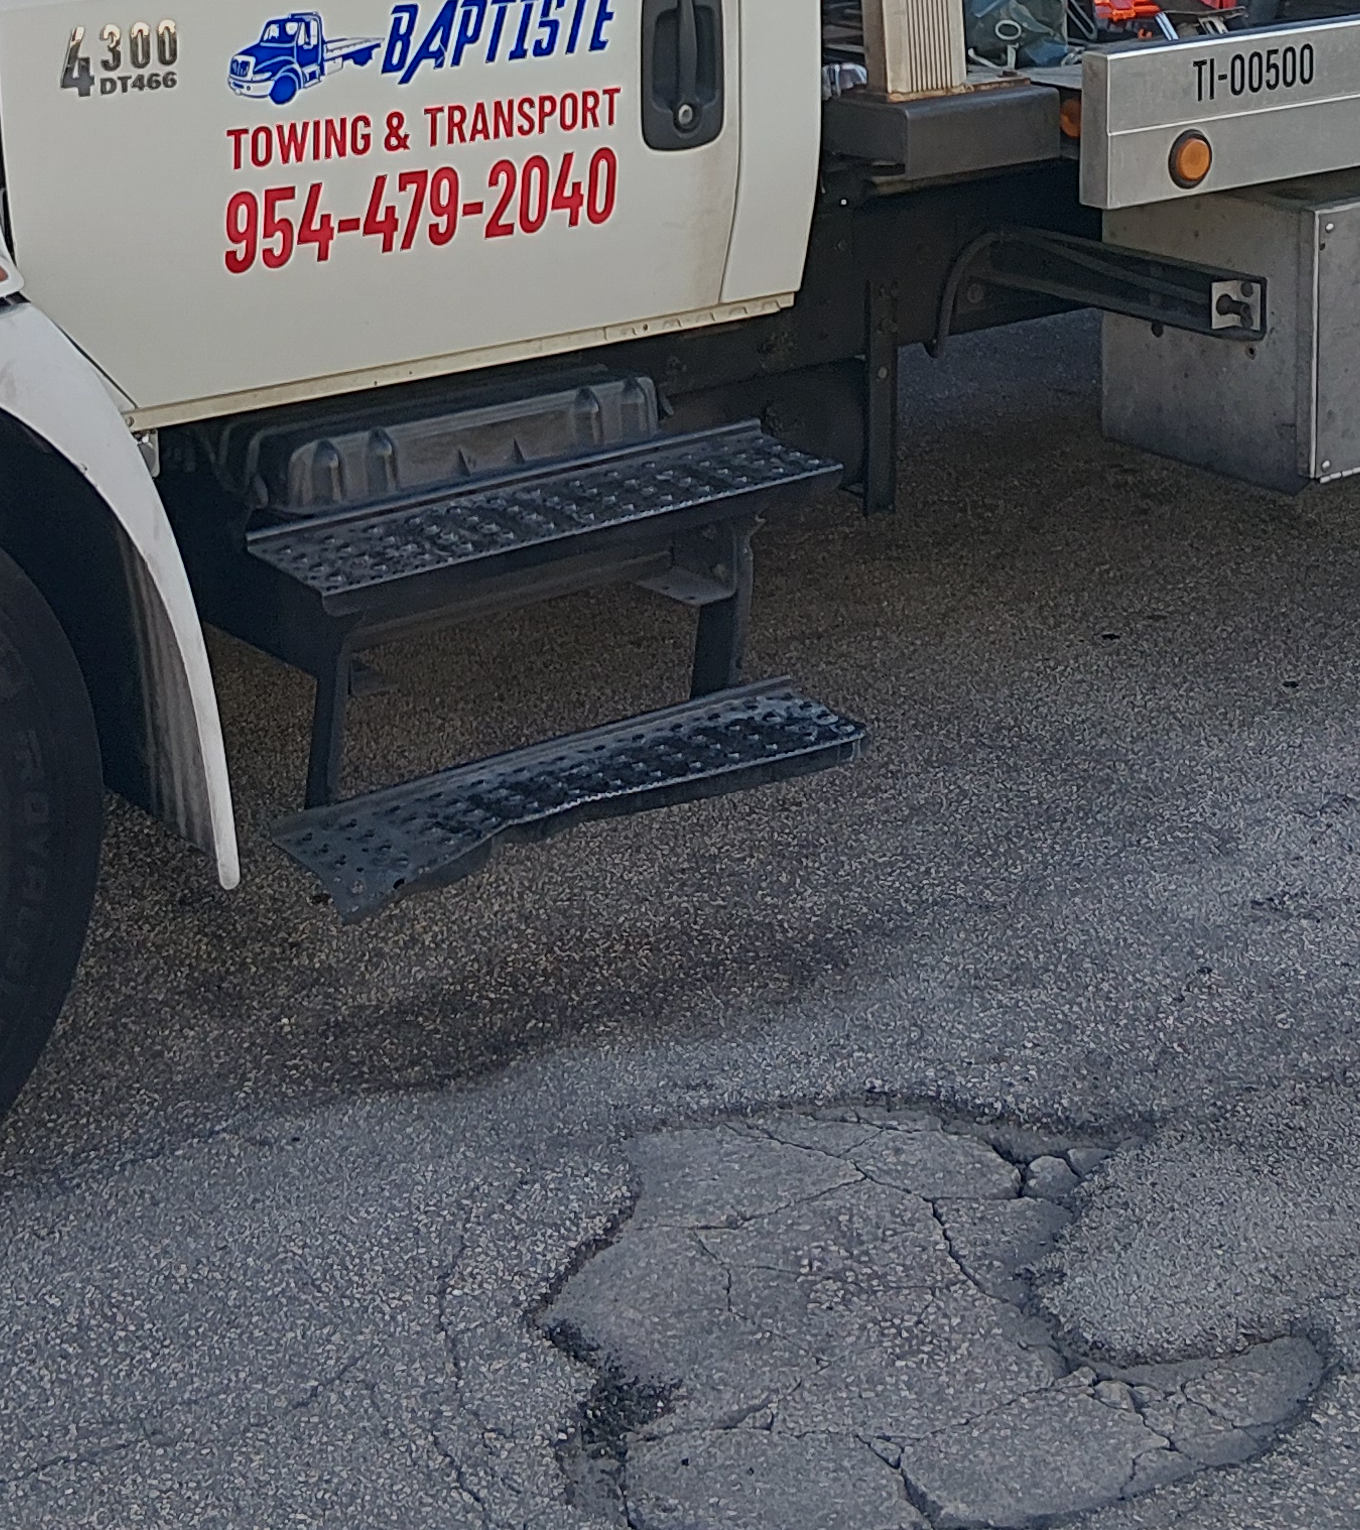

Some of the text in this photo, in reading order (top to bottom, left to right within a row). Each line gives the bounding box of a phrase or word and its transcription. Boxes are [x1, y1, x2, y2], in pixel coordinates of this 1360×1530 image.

[60, 19, 178, 97] 4300
[99, 71, 178, 95] DT466
[1193, 43, 1315, 102] TI-00500
[226, 87, 621, 170] TOWING & TRANSPORT
[224, 147, 617, 274] 954-479-2040
